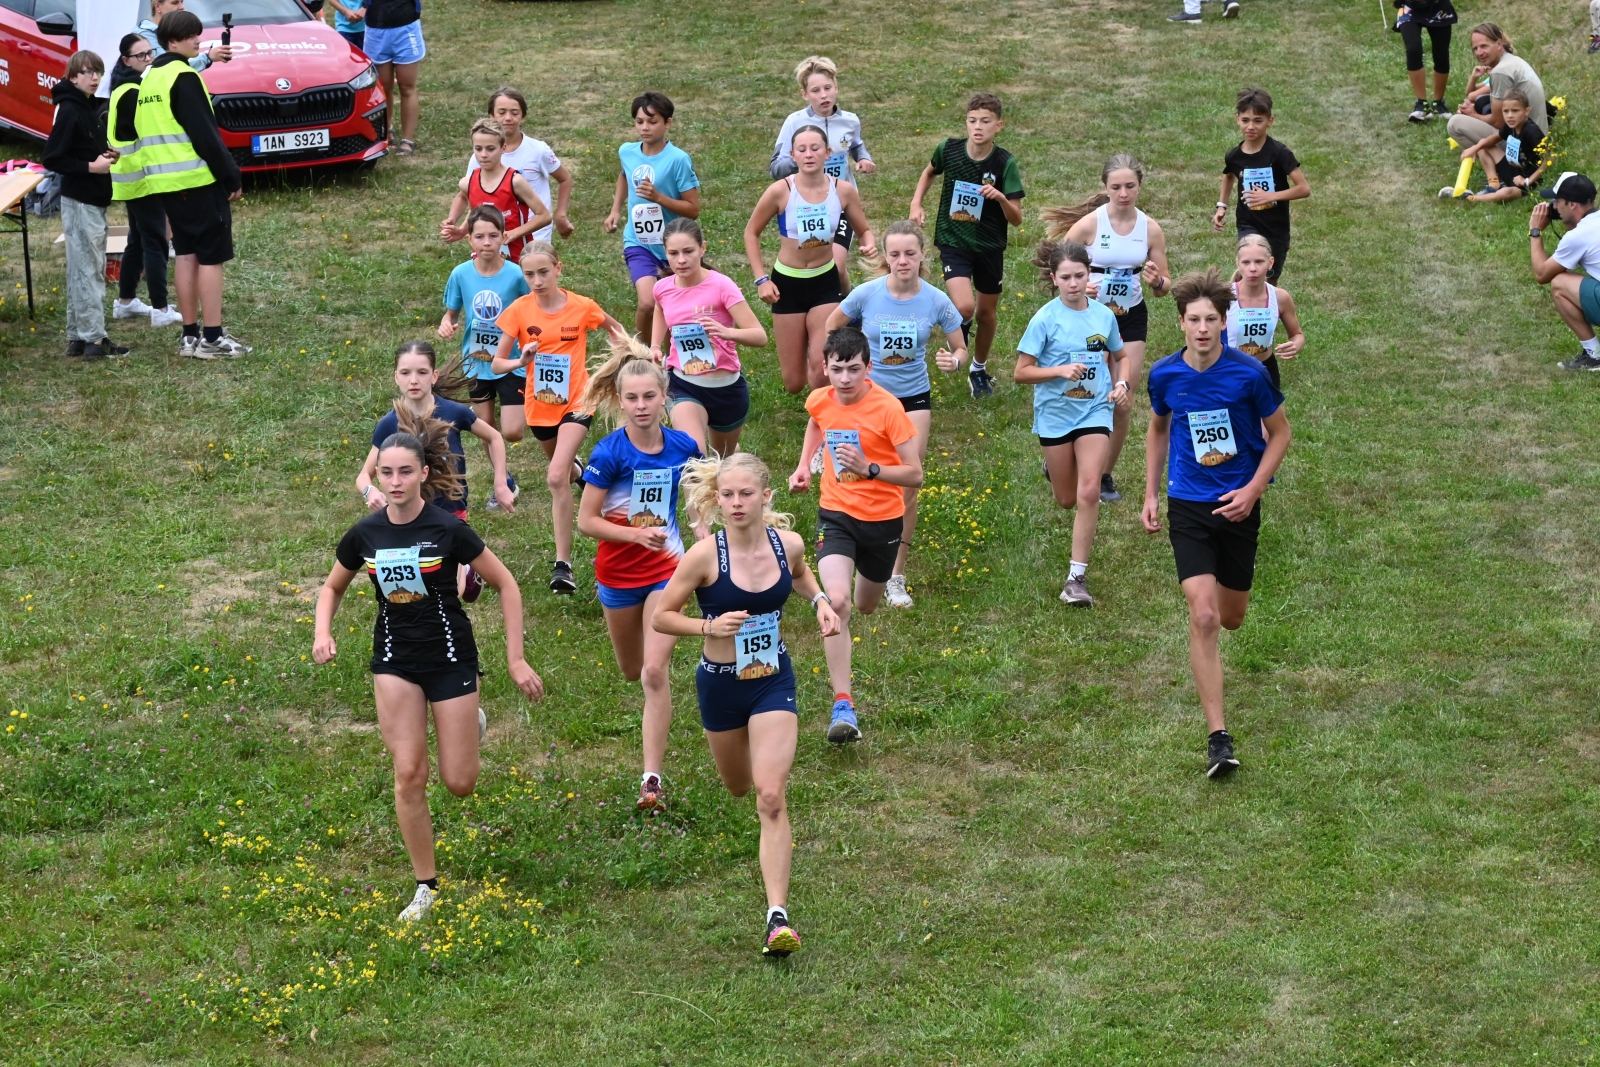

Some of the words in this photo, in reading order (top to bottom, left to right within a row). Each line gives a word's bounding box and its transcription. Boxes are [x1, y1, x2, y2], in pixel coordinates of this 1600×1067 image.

[255, 42, 327, 50] Branka
[37, 72, 62, 90] SKO
[264, 136, 285, 150] 1AN
[294, 132, 324, 147] S923
[957, 194, 978, 207] 159
[634, 220, 663, 234] 507
[802, 218, 825, 232] 164
[1106, 284, 1128, 296] 152
[1244, 323, 1268, 336] 165
[476, 333, 498, 346] 162
[680, 338, 705, 352] 199
[884, 336, 913, 350] 243
[539, 368, 564, 383] 163
[1195, 426, 1230, 444] 250
[639, 487, 662, 502] 161
[381, 565, 416, 582] 253
[743, 634, 772, 654] 153
